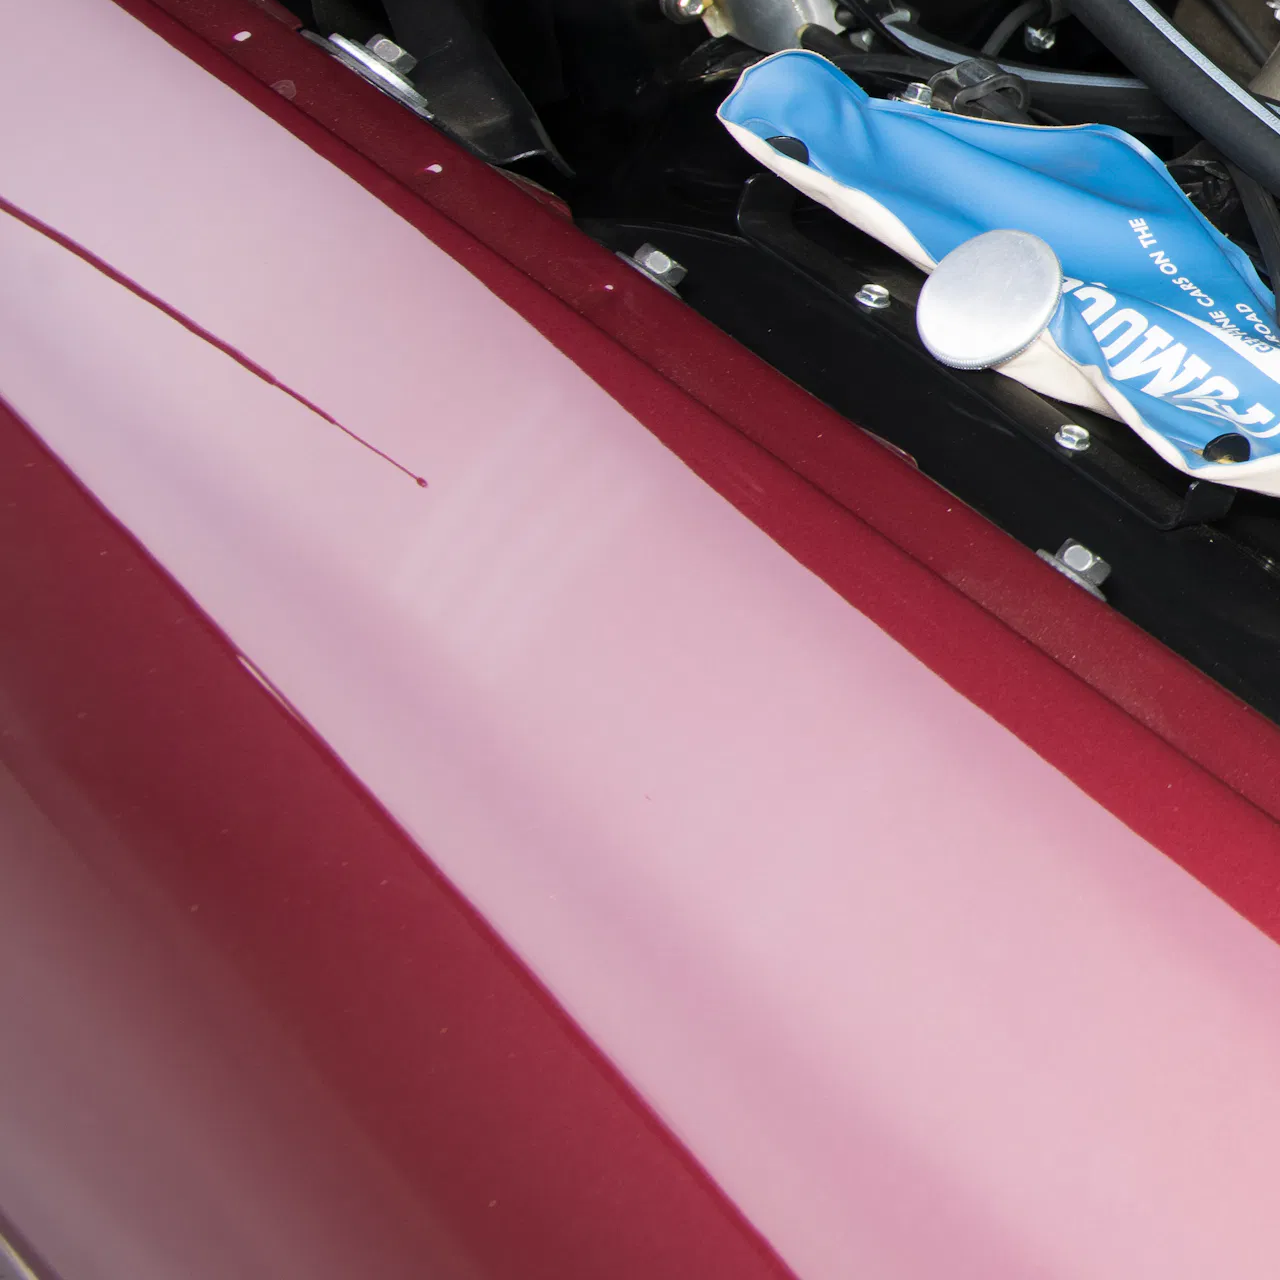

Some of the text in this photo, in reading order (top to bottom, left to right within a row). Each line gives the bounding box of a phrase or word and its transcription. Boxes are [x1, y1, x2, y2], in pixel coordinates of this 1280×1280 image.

[1128, 217, 1158, 250] THE
[1149, 250, 1179, 278] ON
[1171, 266, 1216, 310] CARS
